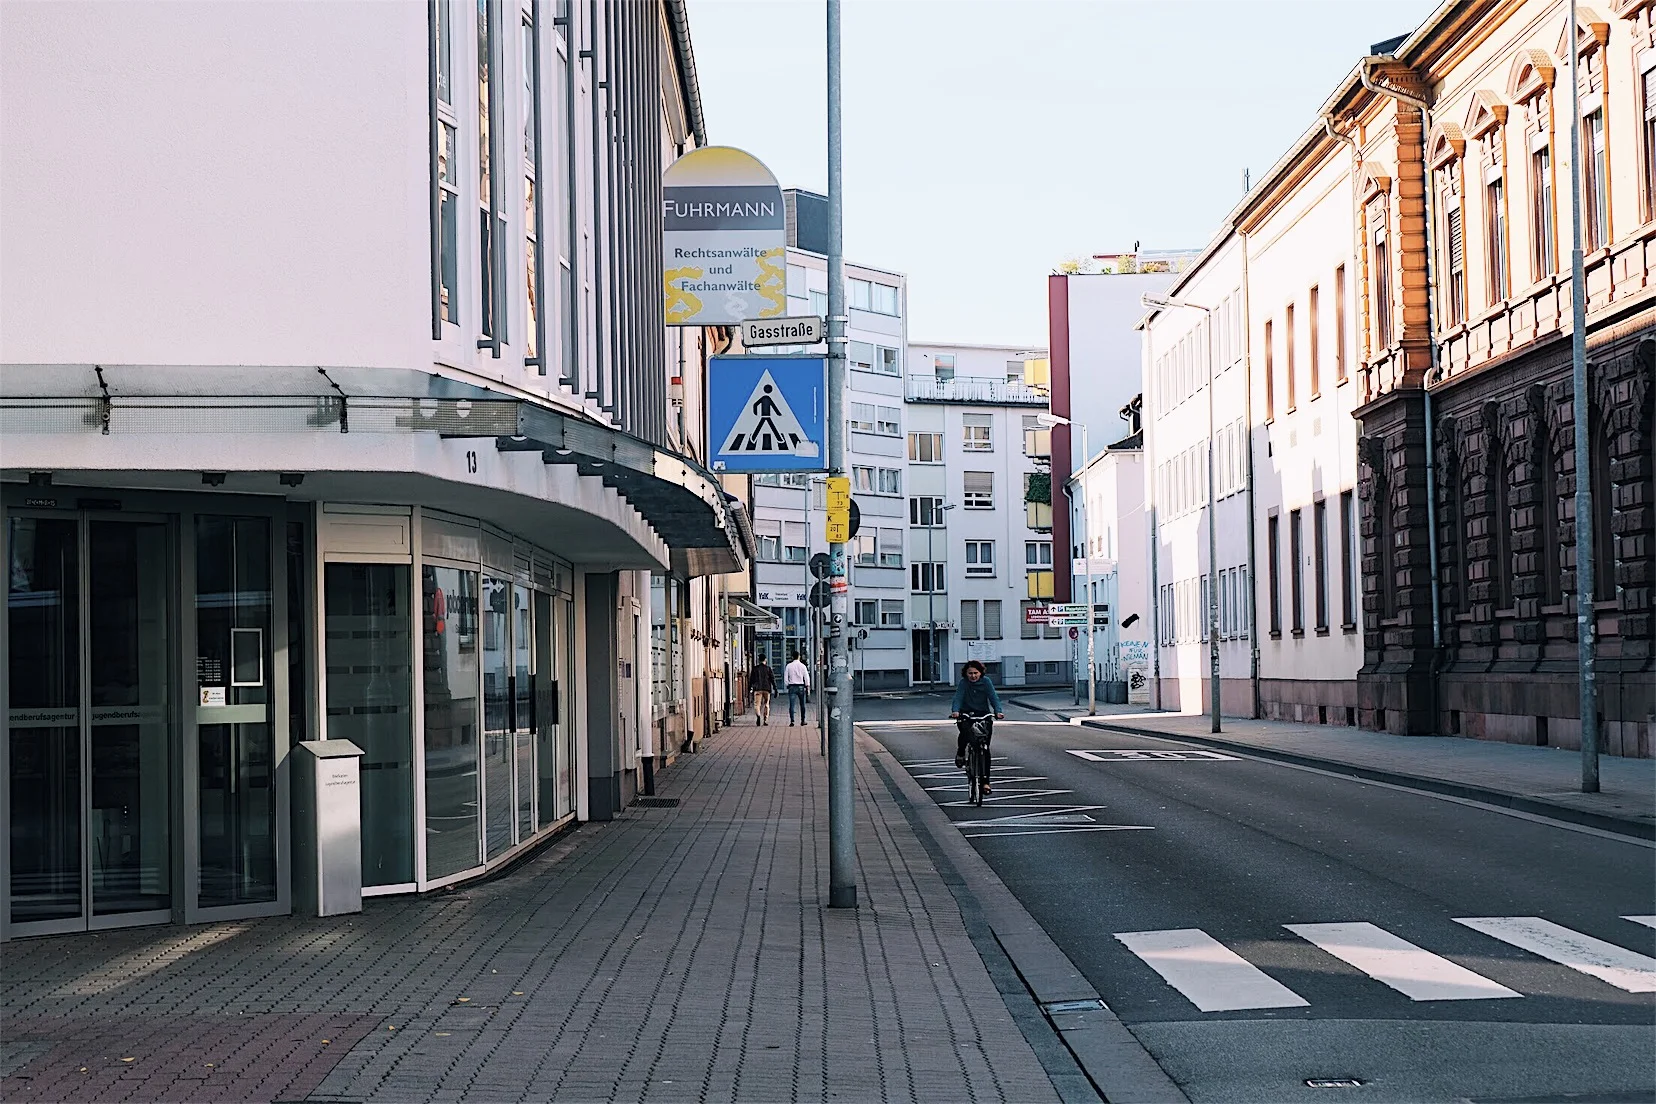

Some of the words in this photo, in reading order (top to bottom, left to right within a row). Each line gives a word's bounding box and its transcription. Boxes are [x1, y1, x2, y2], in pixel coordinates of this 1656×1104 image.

[663, 200, 775, 218] FUHRMANN
[674, 247, 767, 258] Rechtsanwälte
[709, 264, 733, 275] und
[681, 280, 761, 292] Fachanwälte
[750, 322, 813, 339] Gasstraße
[466, 450, 477, 474] 13
